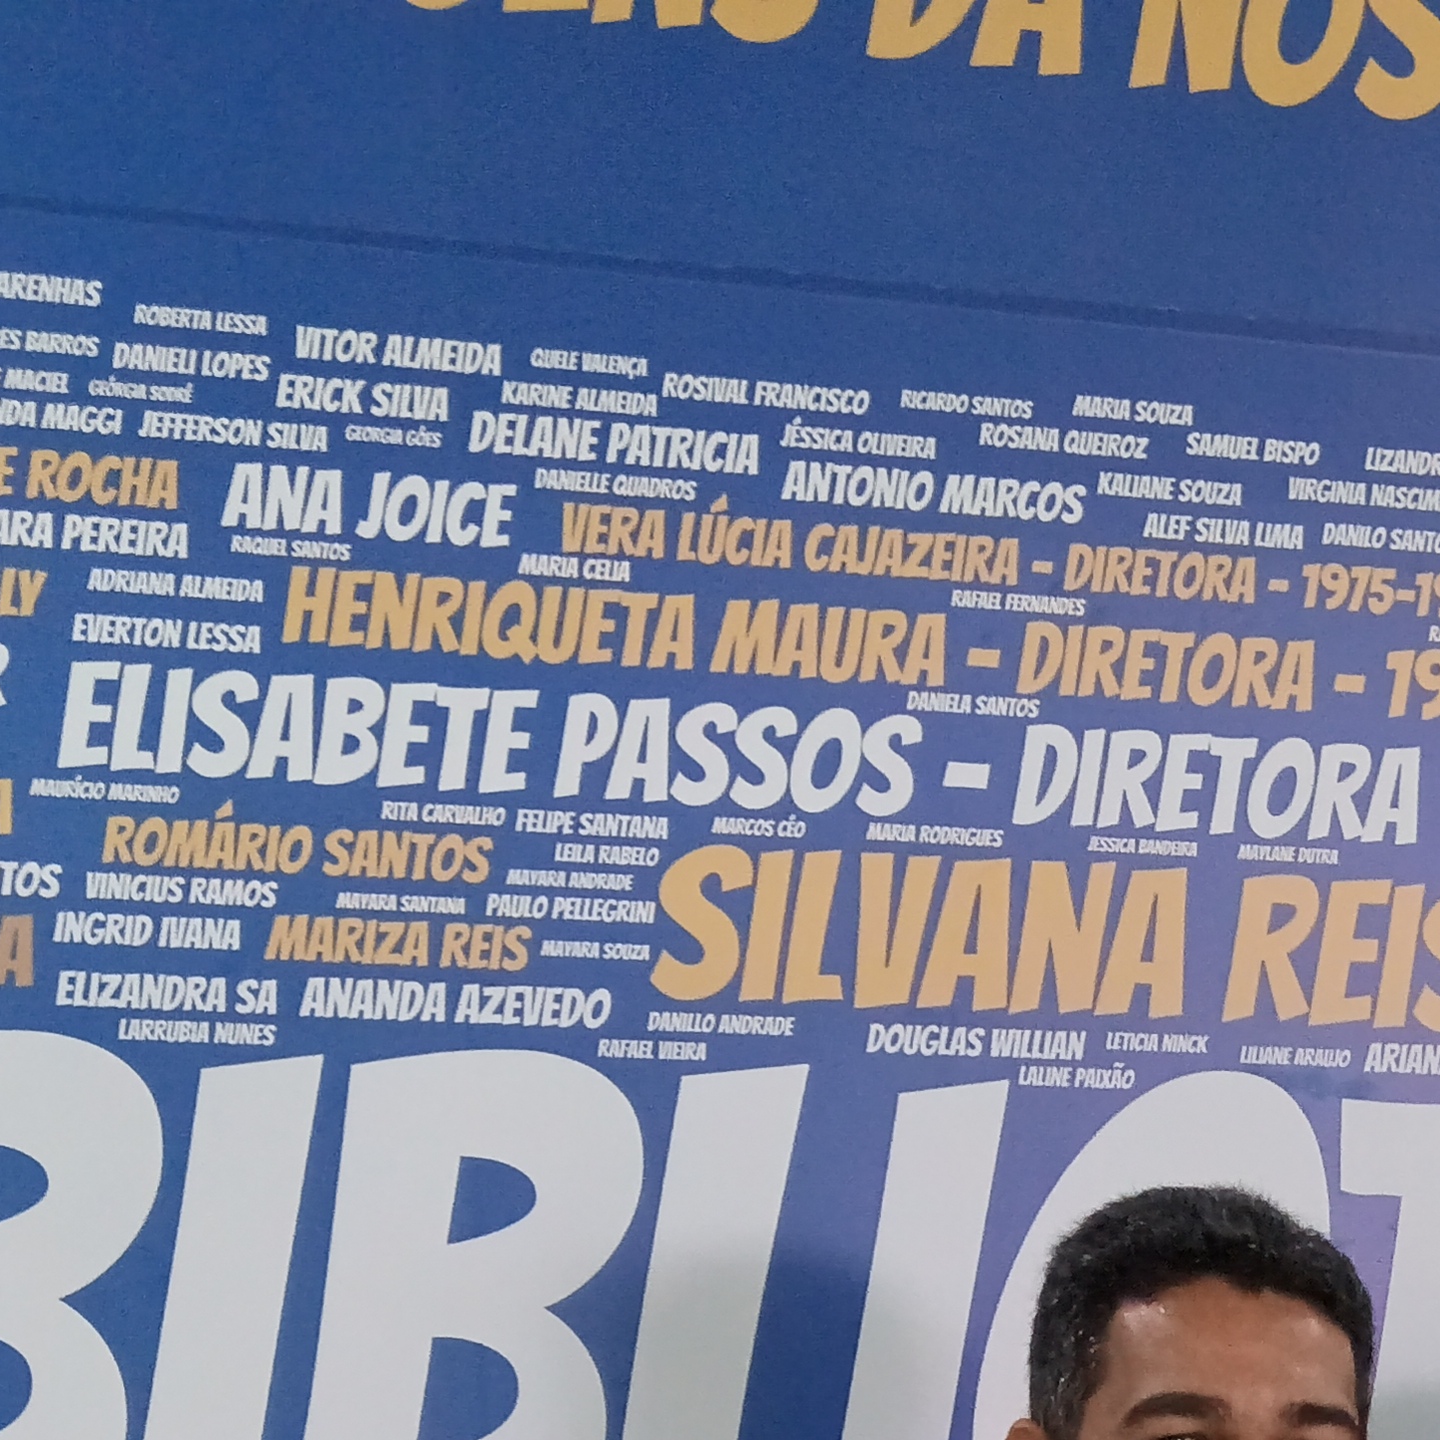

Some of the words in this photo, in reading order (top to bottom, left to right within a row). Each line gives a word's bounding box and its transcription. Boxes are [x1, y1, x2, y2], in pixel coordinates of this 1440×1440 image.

[26, 450, 178, 509] ROCHA
[221, 463, 342, 534] ANA
[355, 472, 517, 547] JOICE
[781, 461, 934, 511] ANTONIO
[939, 475, 1086, 523] MARCOS
[563, 503, 664, 559] VERA
[677, 494, 792, 568] LÚCIA
[805, 523, 1019, 585] CAJAZEIRA
[1064, 544, 1255, 603] DIRETORA
[282, 559, 694, 670] HENRIQUETA
[710, 599, 946, 686] MAURA
[1017, 621, 1314, 711] DIRETORA
[58, 660, 540, 795] ELISABETE
[554, 693, 922, 816] PASSOS
[1012, 724, 1420, 845] DIRETORA
[102, 800, 313, 874] ROMÁRIO
[323, 829, 493, 883] SANTOS
[265, 915, 428, 966] MARIZA
[440, 923, 532, 971] REIS
[649, 843, 1193, 1010] SILVANA
